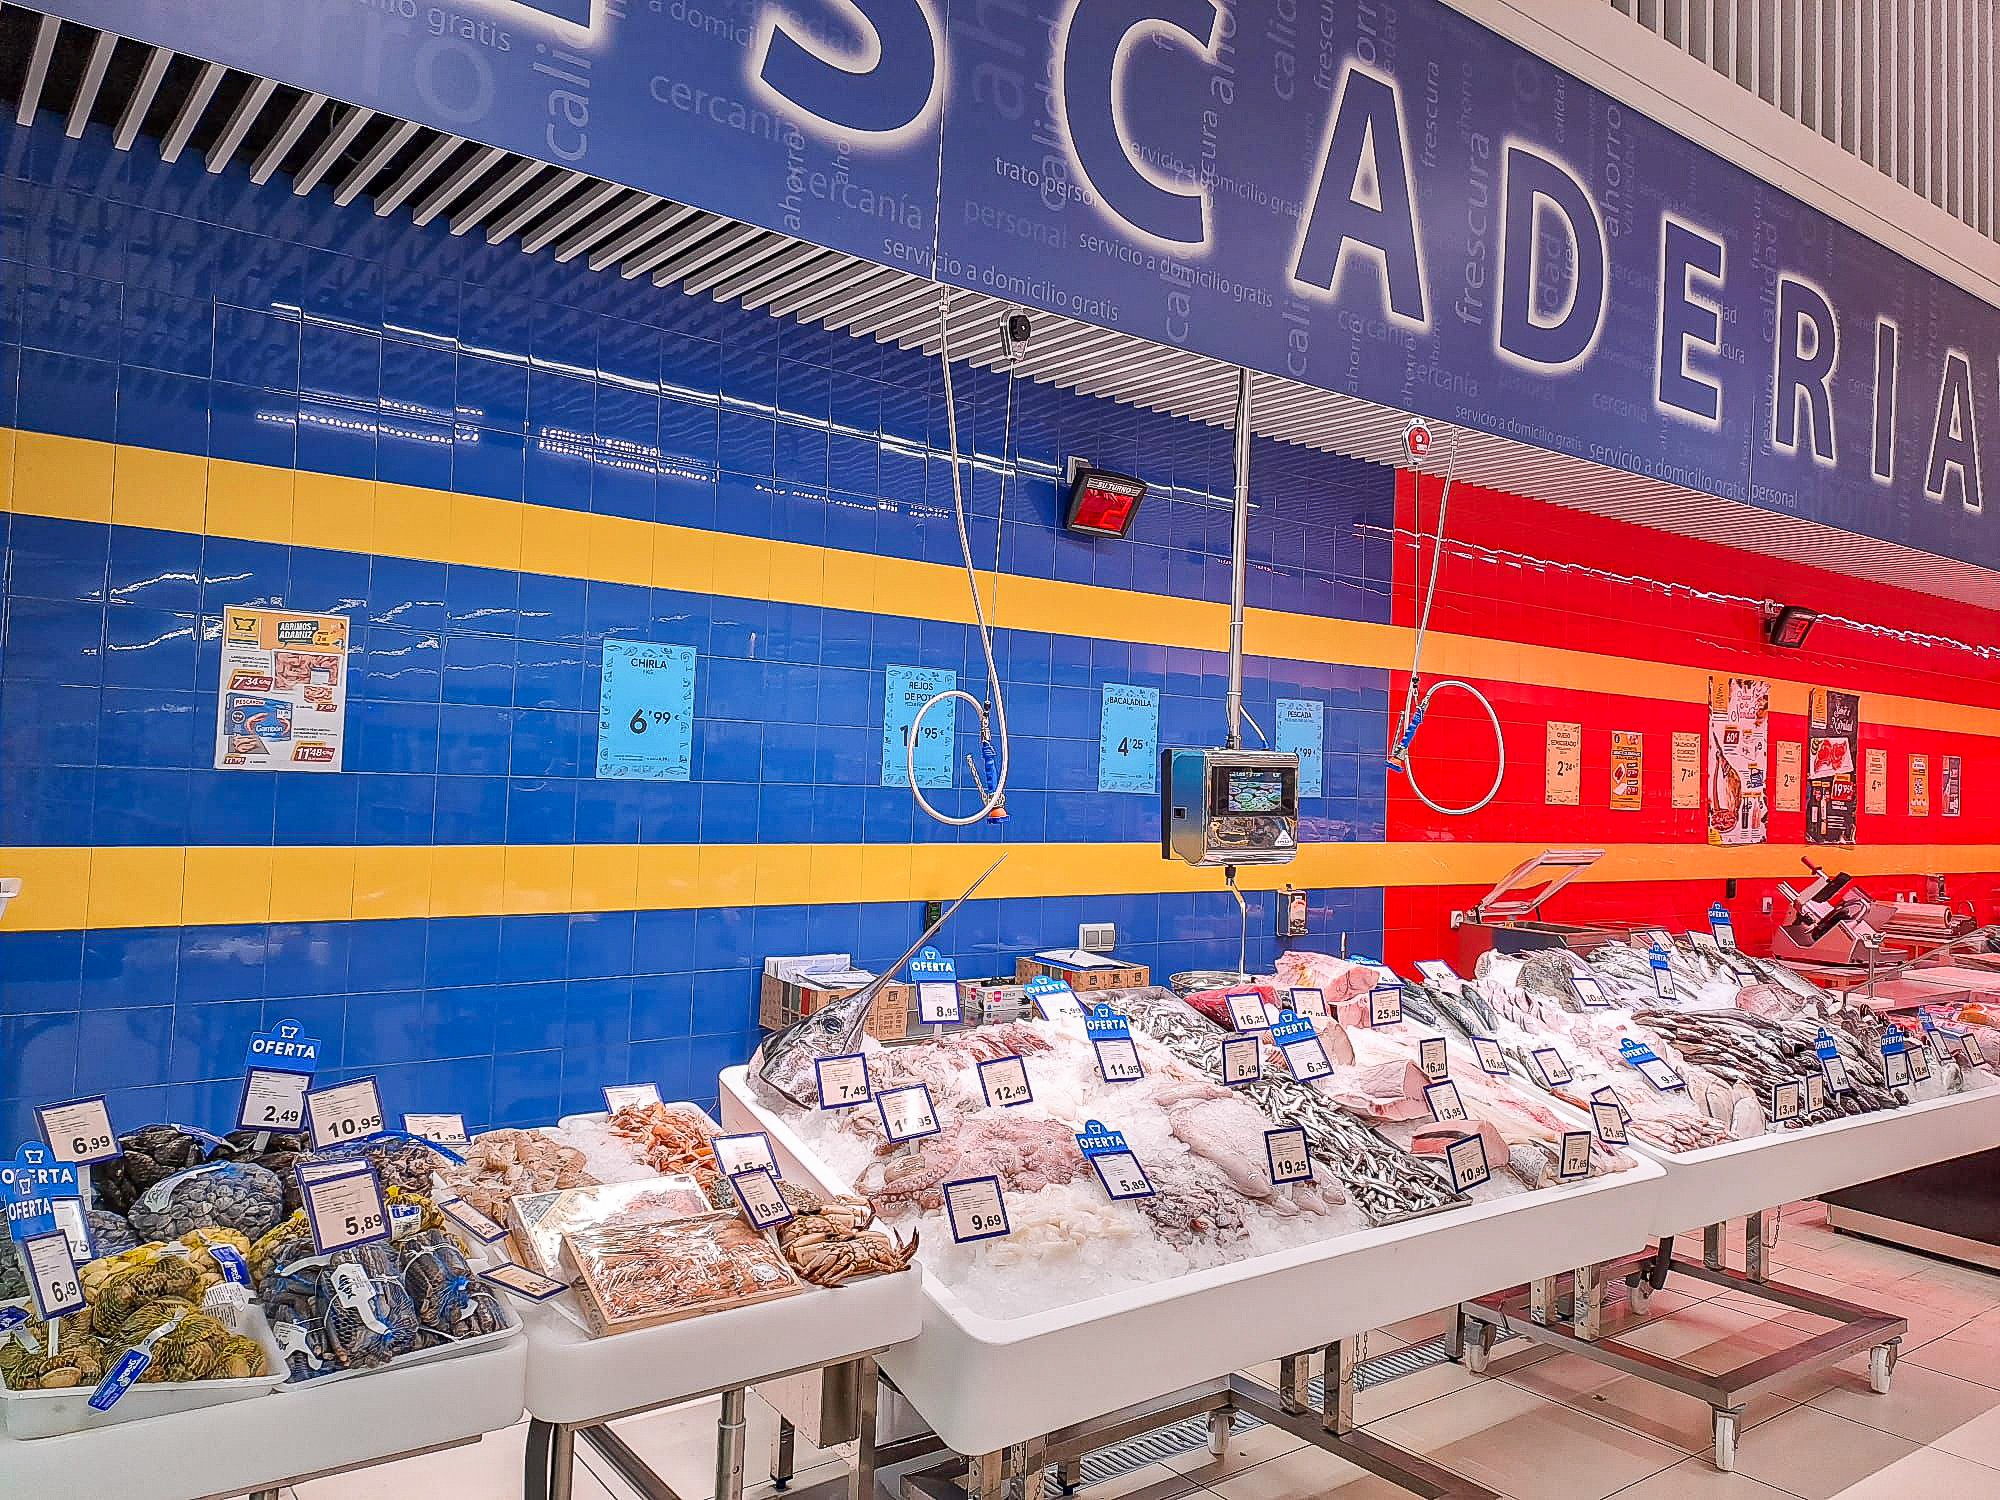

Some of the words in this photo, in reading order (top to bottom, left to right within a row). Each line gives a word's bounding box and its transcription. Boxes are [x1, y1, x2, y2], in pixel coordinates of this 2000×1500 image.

[429, 9, 514, 52] gratis
[1420, 59, 1441, 169] frescura
[993, 156, 1040, 188] trato
[1601, 104, 1622, 240] ahorro
[963, 200, 1068, 250] personal
[1454, 132, 1491, 326] frescura
[1079, 230, 1145, 267] servicio
[1146, 254, 1157, 271] a
[1159, 253, 1230, 297] domicilio
[1233, 283, 1274, 309] gratis
[882, 237, 961, 277] servicio
[966, 262, 978, 282] a
[982, 261, 1068, 307] domicilio
[1071, 297, 1121, 323] gratis
[1454, 404, 1497, 428] servicio
[1506, 416, 1552, 446] domicilio
[1588, 441, 1641, 475] servicio
[1643, 458, 1653, 475] a
[1656, 458, 1712, 491] domicilio
[1714, 475, 1748, 502] gratis
[1108, 484, 1132, 494] TURNO
[1750, 481, 1798, 510] personal
[630, 658, 667, 670] CHIRLA
[908, 681, 934, 691] REJOS
[1109, 696, 1153, 709] BACALADILLA
[911, 961, 954, 973] OFERTA
[1026, 982, 1069, 995] OFERTA
[935, 1005, 959, 1018] 8,95
[1377, 1008, 1400, 1020] 25,95
[1086, 1019, 1128, 1032] OFERTA
[1272, 1021, 1313, 1038] OFERTA
[252, 1040, 317, 1059] OFERTA
[1881, 1035, 1905, 1049] OFERTA
[1620, 1045, 1651, 1059] OFERTA
[1110, 1063, 1140, 1077] 11,95
[1238, 1064, 1257, 1077] 6,49
[1306, 1061, 1329, 1074] 6,35
[839, 1085, 868, 1099] 7,49
[994, 1085, 1027, 1101] 12,49
[263, 1105, 299, 1123] 2,49
[327, 1114, 382, 1139] 10,95
[894, 1115, 933, 1134] 1,95
[72, 1135, 111, 1155] 6,99
[1079, 1136, 1126, 1150] OFERTA
[733, 1160, 775, 1174] 155
[1276, 1159, 1308, 1176] 19,25
[1460, 1165, 1487, 1184] 10,95
[0, 1168, 75, 1185] OERTA
[1120, 1178, 1147, 1193] 5,89
[8, 1197, 52, 1221] OFERTA
[754, 1200, 785, 1220] 19,59
[344, 1213, 383, 1237] 5,89
[971, 1214, 1002, 1231] 9,69
